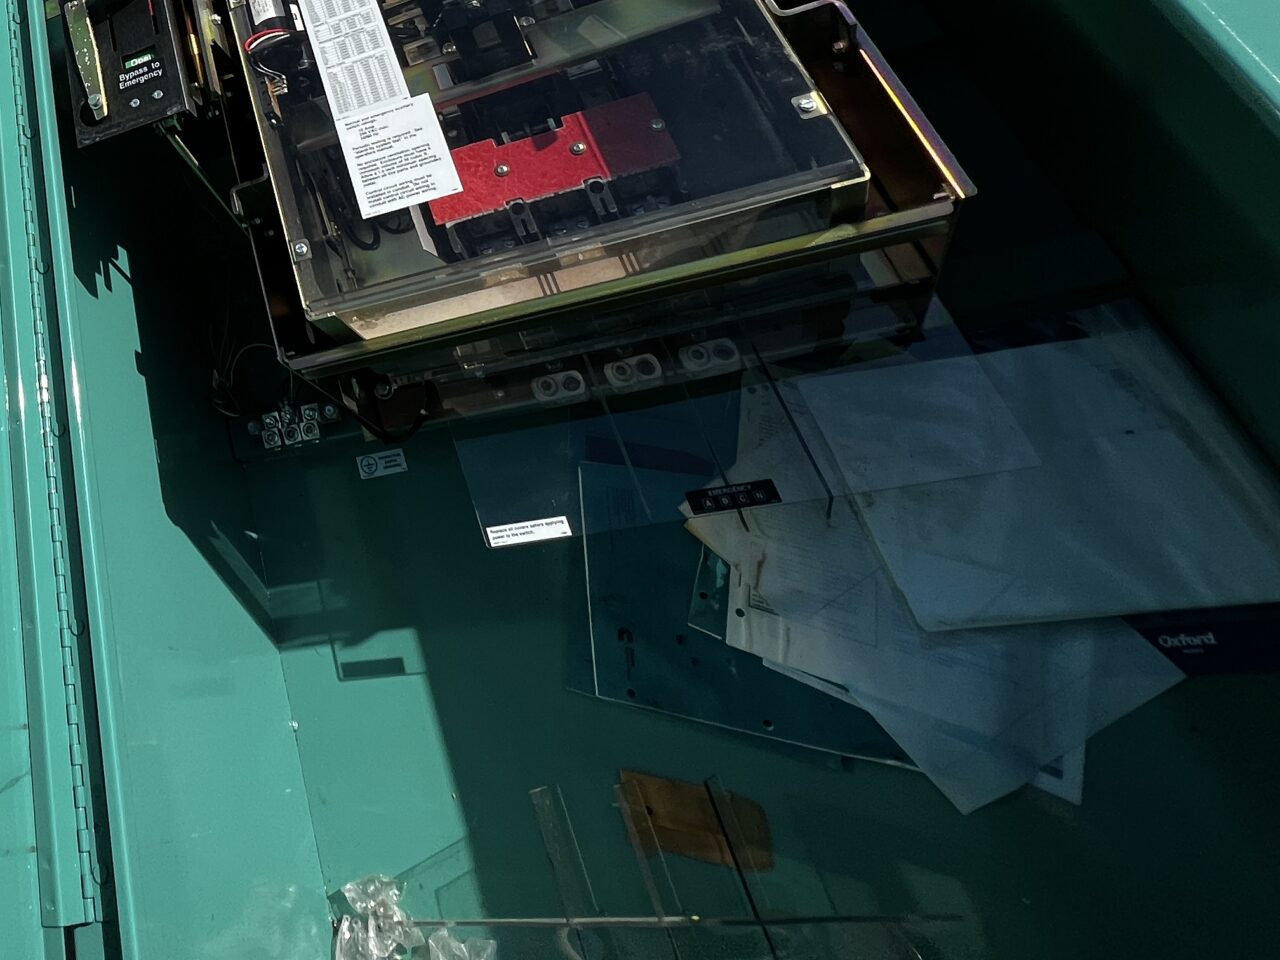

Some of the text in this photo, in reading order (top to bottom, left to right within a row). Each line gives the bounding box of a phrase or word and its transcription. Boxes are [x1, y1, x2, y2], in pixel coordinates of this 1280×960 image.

[118, 66, 148, 82] Bypass
[118, 68, 163, 89] Emergency
[1157, 631, 1217, 647] Oxford
